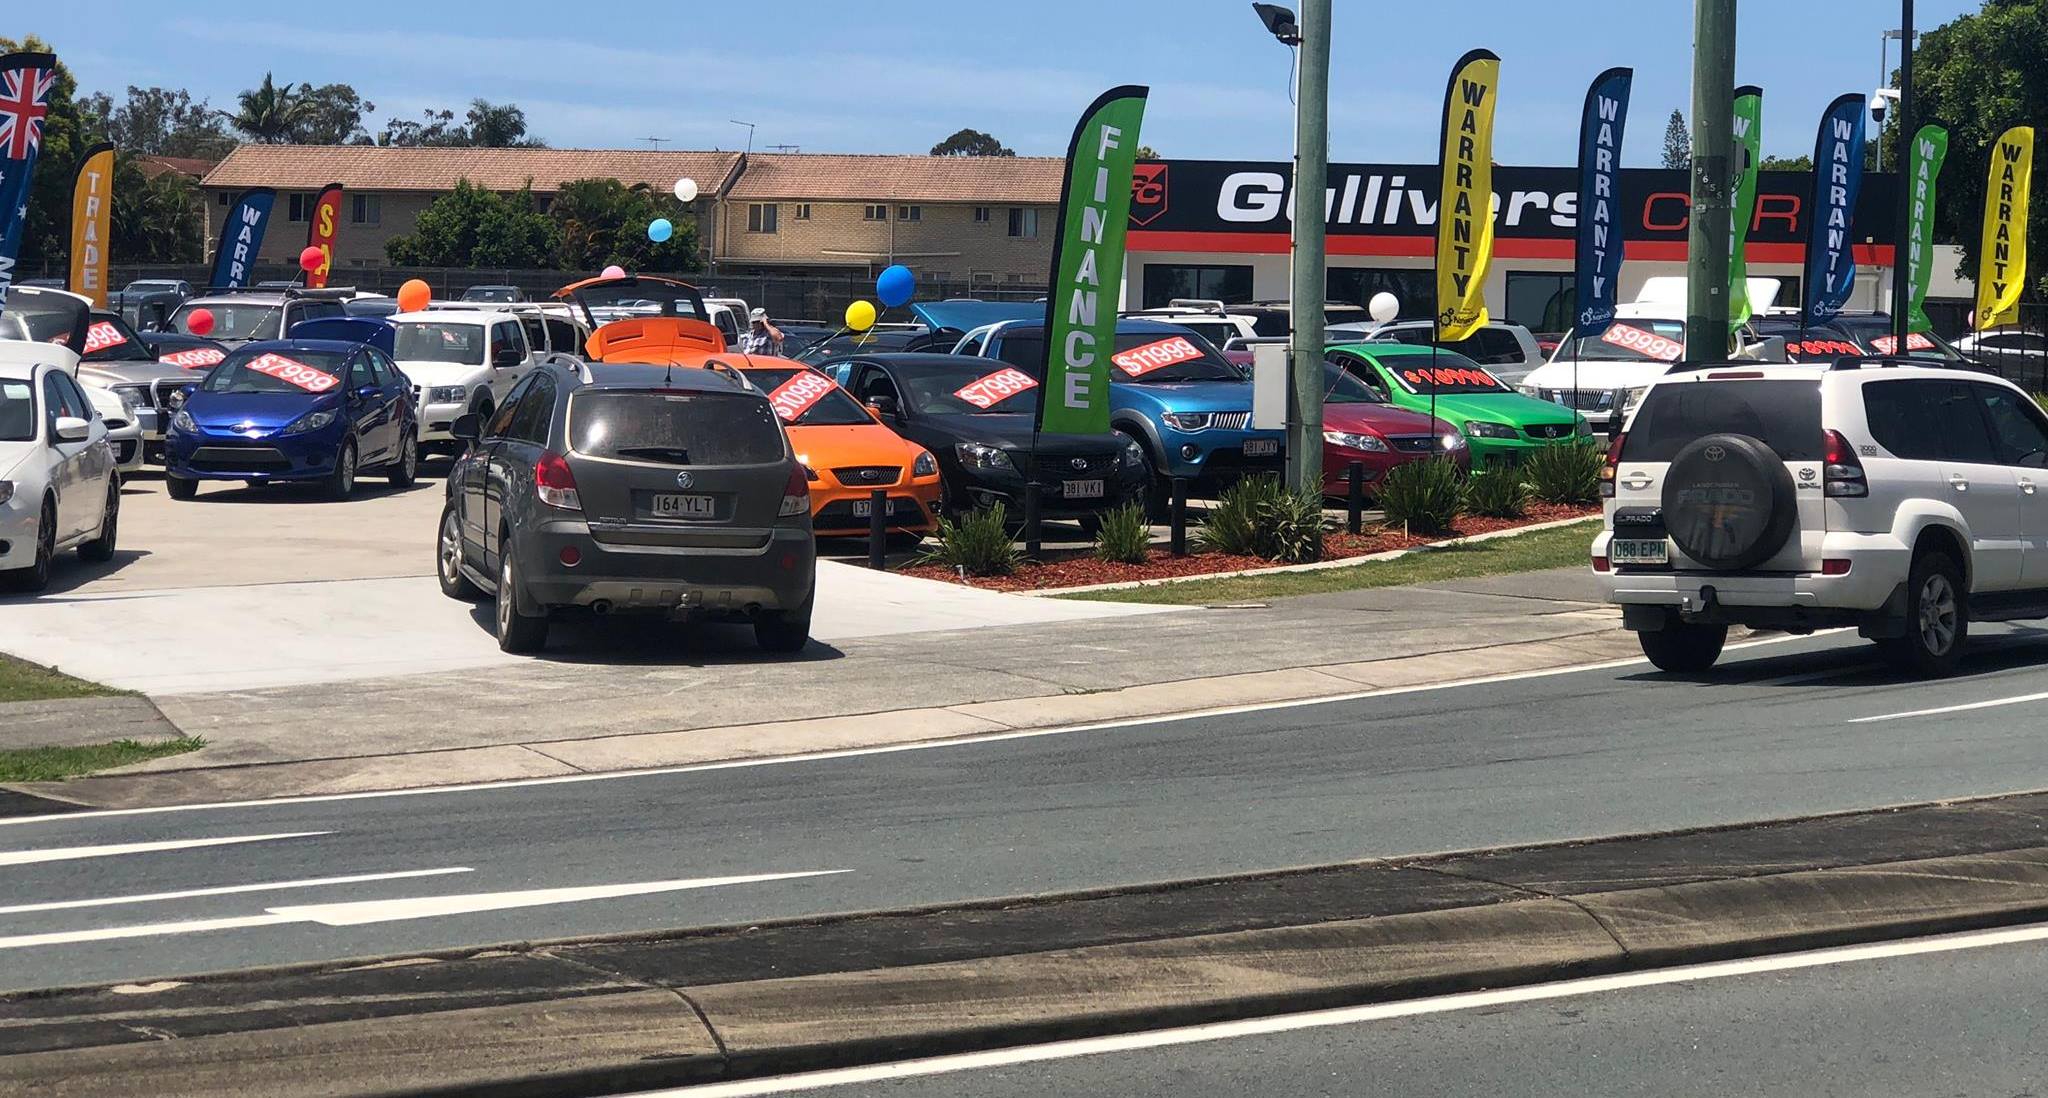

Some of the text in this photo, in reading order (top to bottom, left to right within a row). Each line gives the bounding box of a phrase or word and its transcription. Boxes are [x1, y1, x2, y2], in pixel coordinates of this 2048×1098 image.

[83, 171, 101, 290] TRADE
[1216, 171, 1577, 228] Gllivrs
[1453, 79, 1487, 298] WARRANTY
[1592, 95, 1619, 299] WARRANTY
[1825, 117, 1852, 294] WARRANTY
[1909, 138, 1935, 302] WARRANTY
[1992, 142, 2022, 300] WARRANTY
[1064, 124, 1122, 409] FINANCE
[250, 355, 334, 391] $7999
[774, 374, 829, 417] $10999
[960, 370, 1033, 406] $7999
[1116, 340, 1197, 374] $11999
[1605, 325, 1682, 361] $9999
